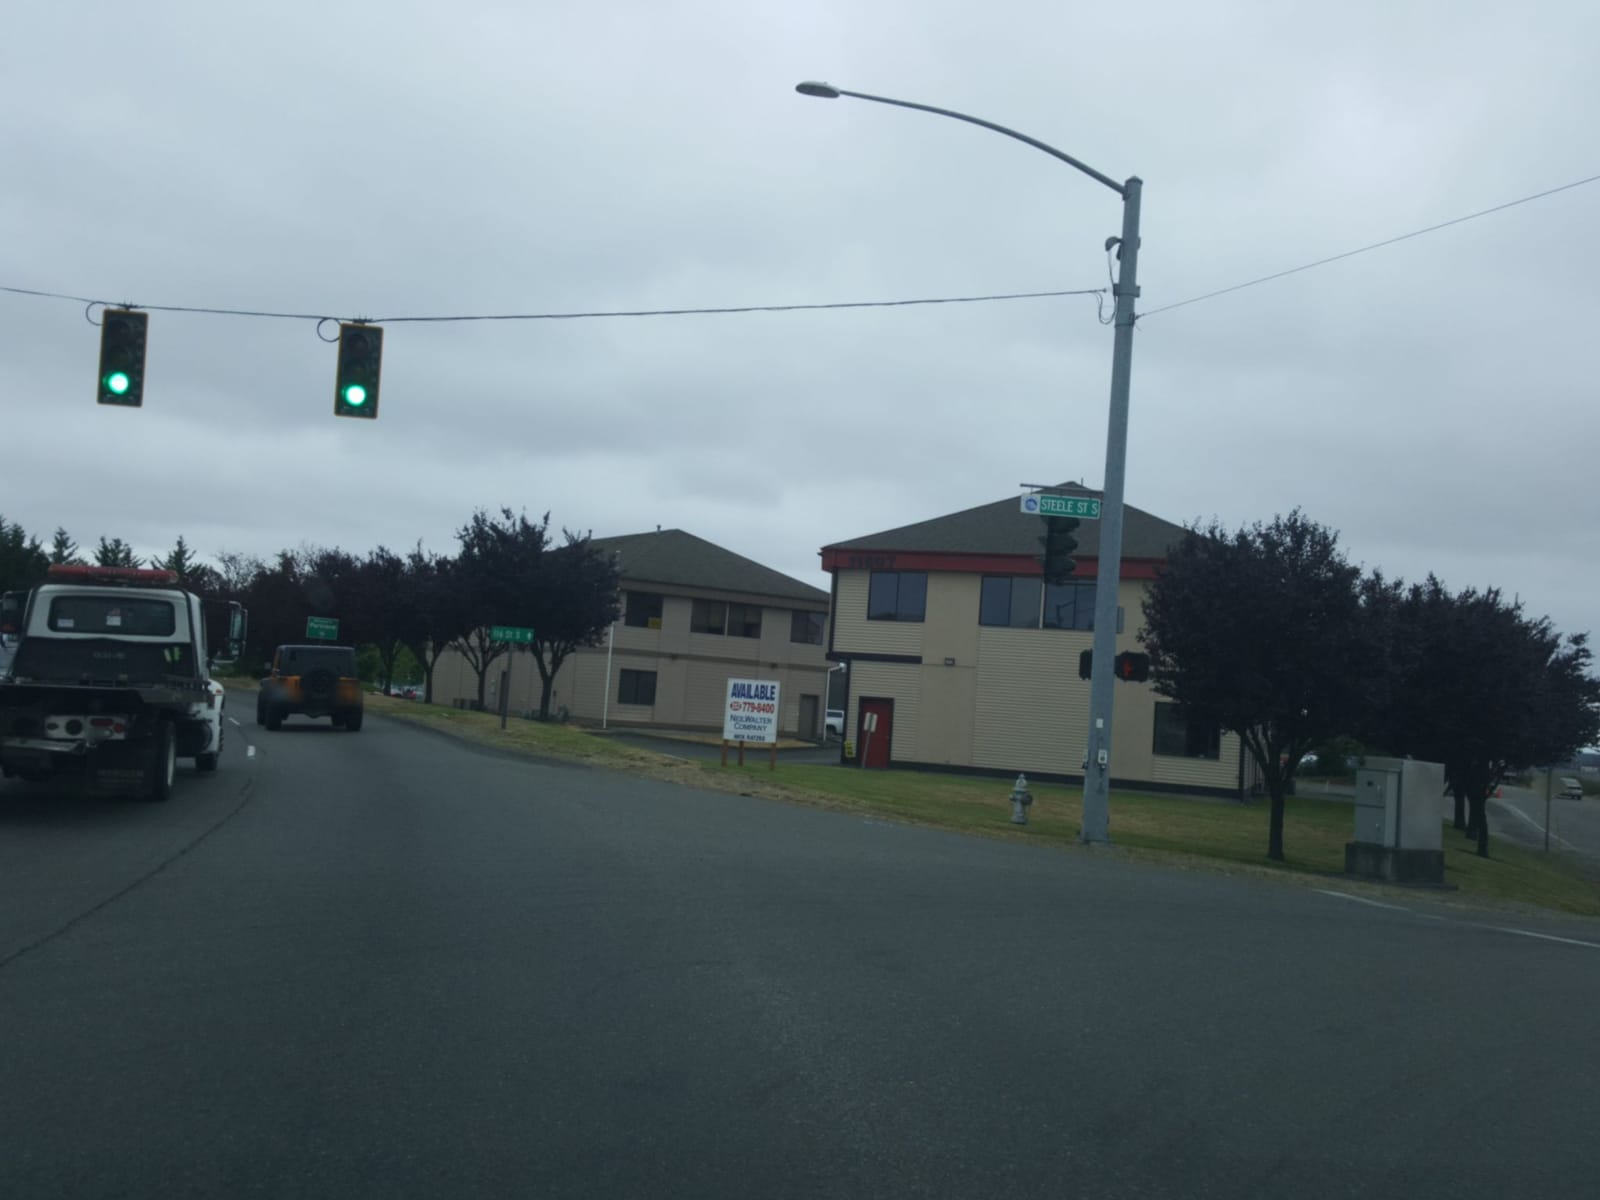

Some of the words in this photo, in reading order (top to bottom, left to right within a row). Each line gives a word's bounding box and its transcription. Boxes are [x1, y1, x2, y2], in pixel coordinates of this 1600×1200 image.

[1041, 499, 1073, 513] STEELE
[1077, 502, 1088, 513] ST
[1091, 503, 1098, 515] S
[731, 682, 776, 701] AVAILABLE
[742, 701, 775, 714] 779-8400
